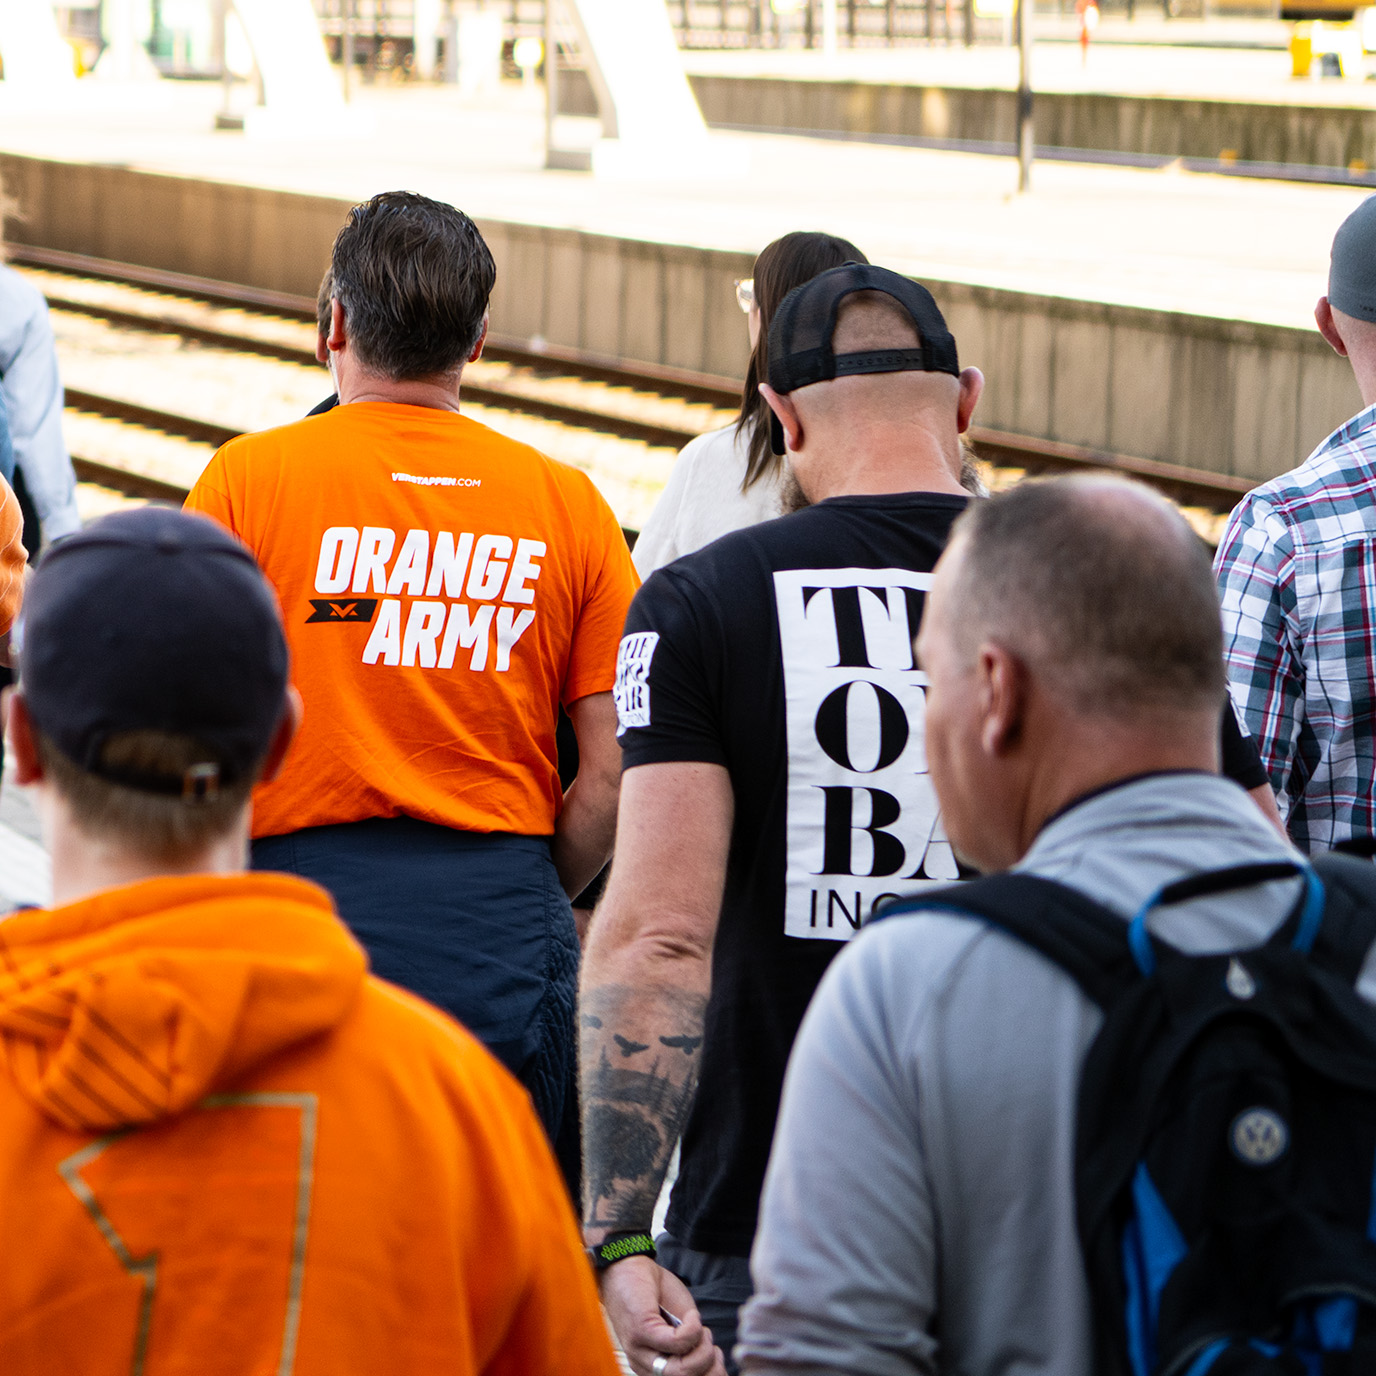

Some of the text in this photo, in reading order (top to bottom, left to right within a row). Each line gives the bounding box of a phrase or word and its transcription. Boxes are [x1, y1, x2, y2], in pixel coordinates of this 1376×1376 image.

[391, 472, 482, 488] VERSTAPPEN.COM
[314, 526, 547, 605] ORANGE
[361, 599, 536, 672] ARMY
